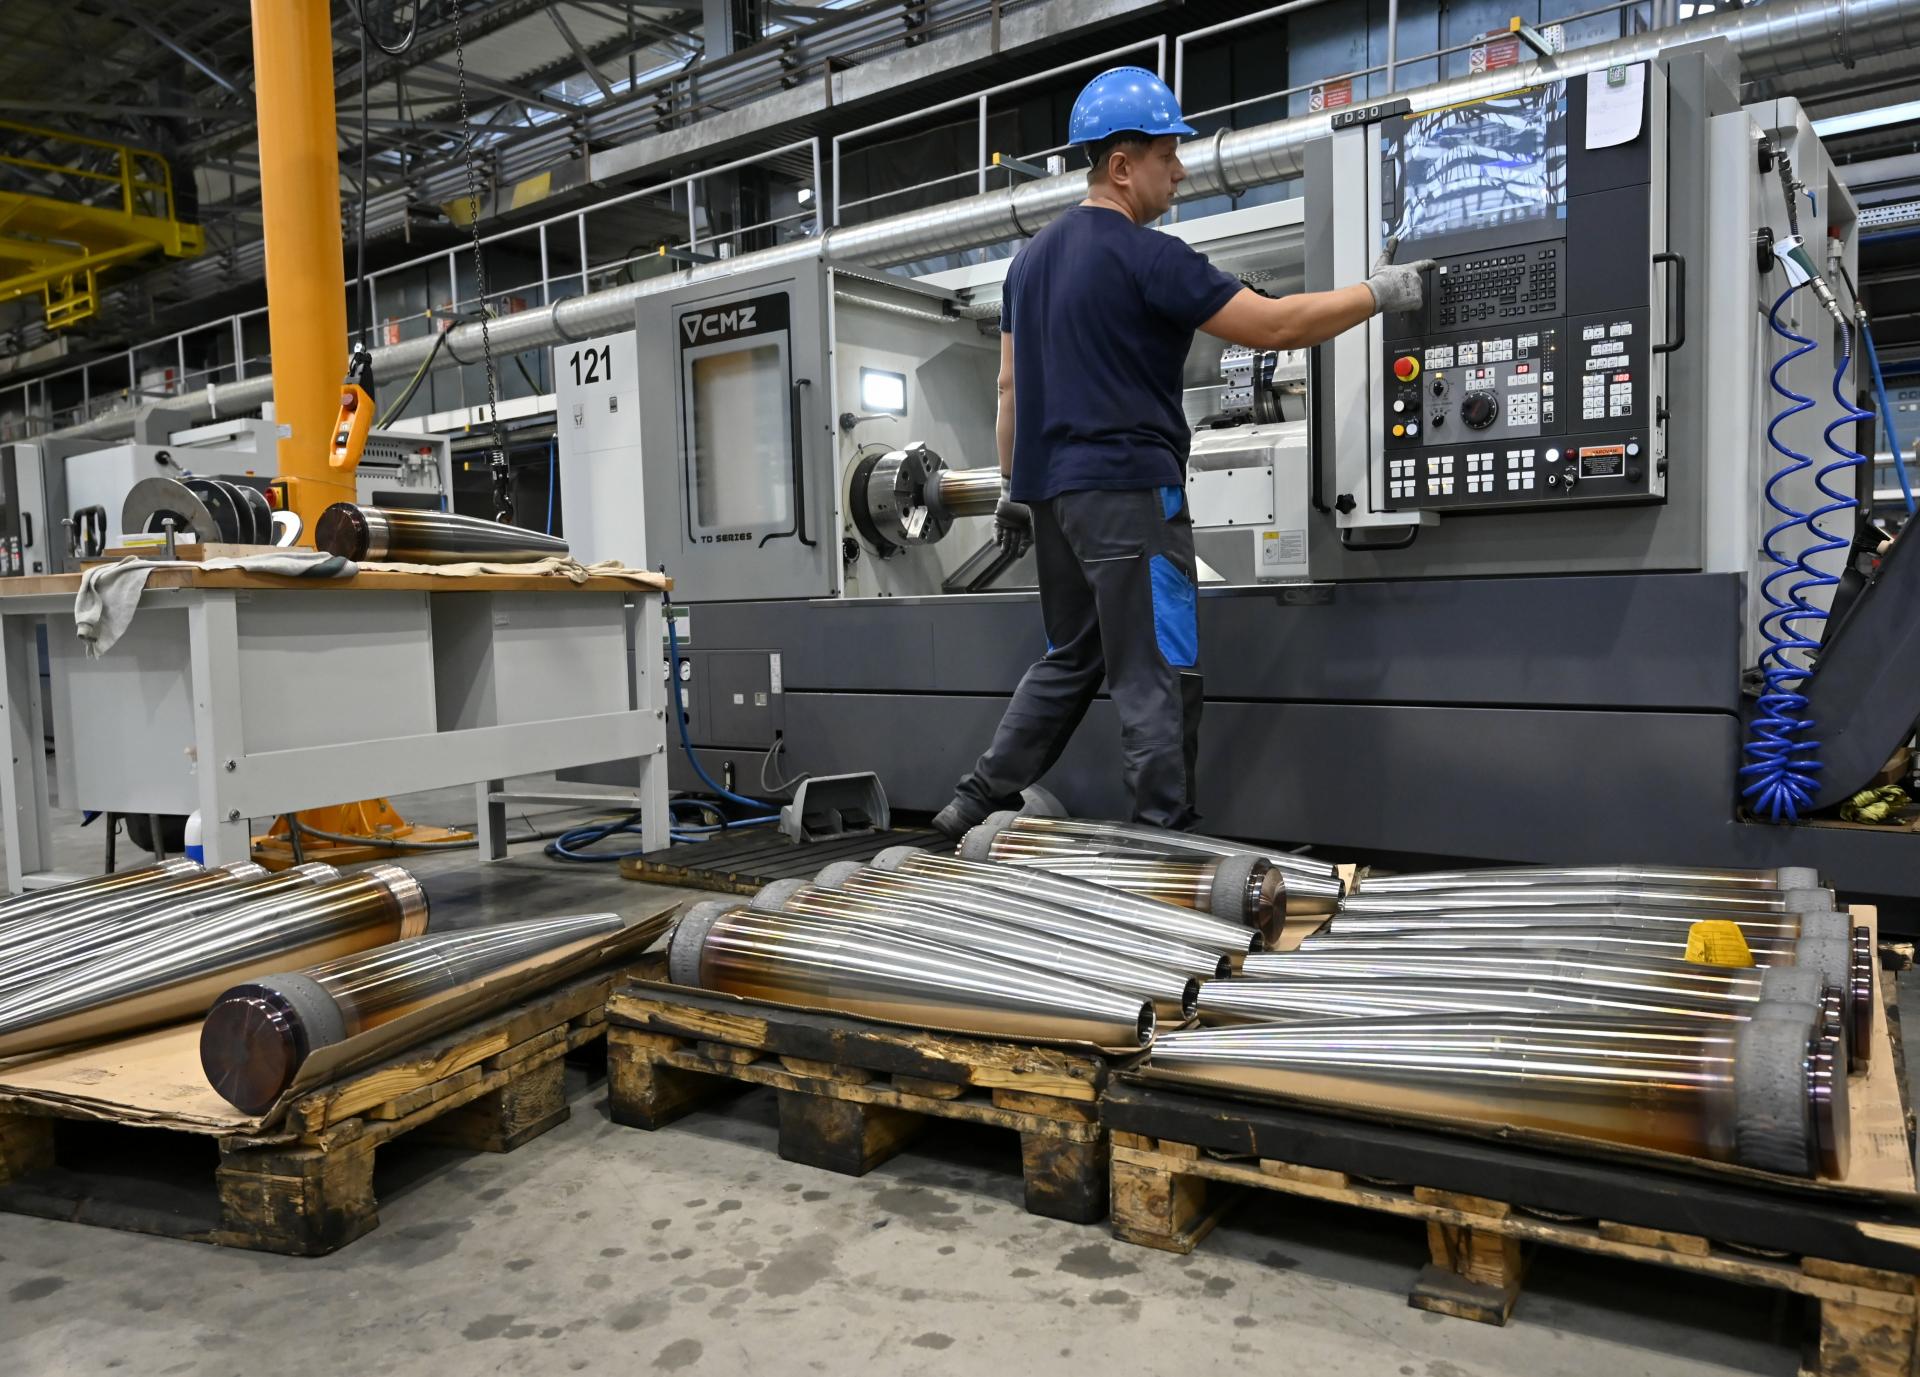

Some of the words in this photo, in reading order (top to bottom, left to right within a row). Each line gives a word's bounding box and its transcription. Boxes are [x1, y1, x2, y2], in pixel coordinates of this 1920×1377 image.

[1333, 107, 1379, 123] TD30
[702, 306, 757, 337] CMZ
[570, 345, 611, 386] 121
[716, 532, 753, 543] SERIES
